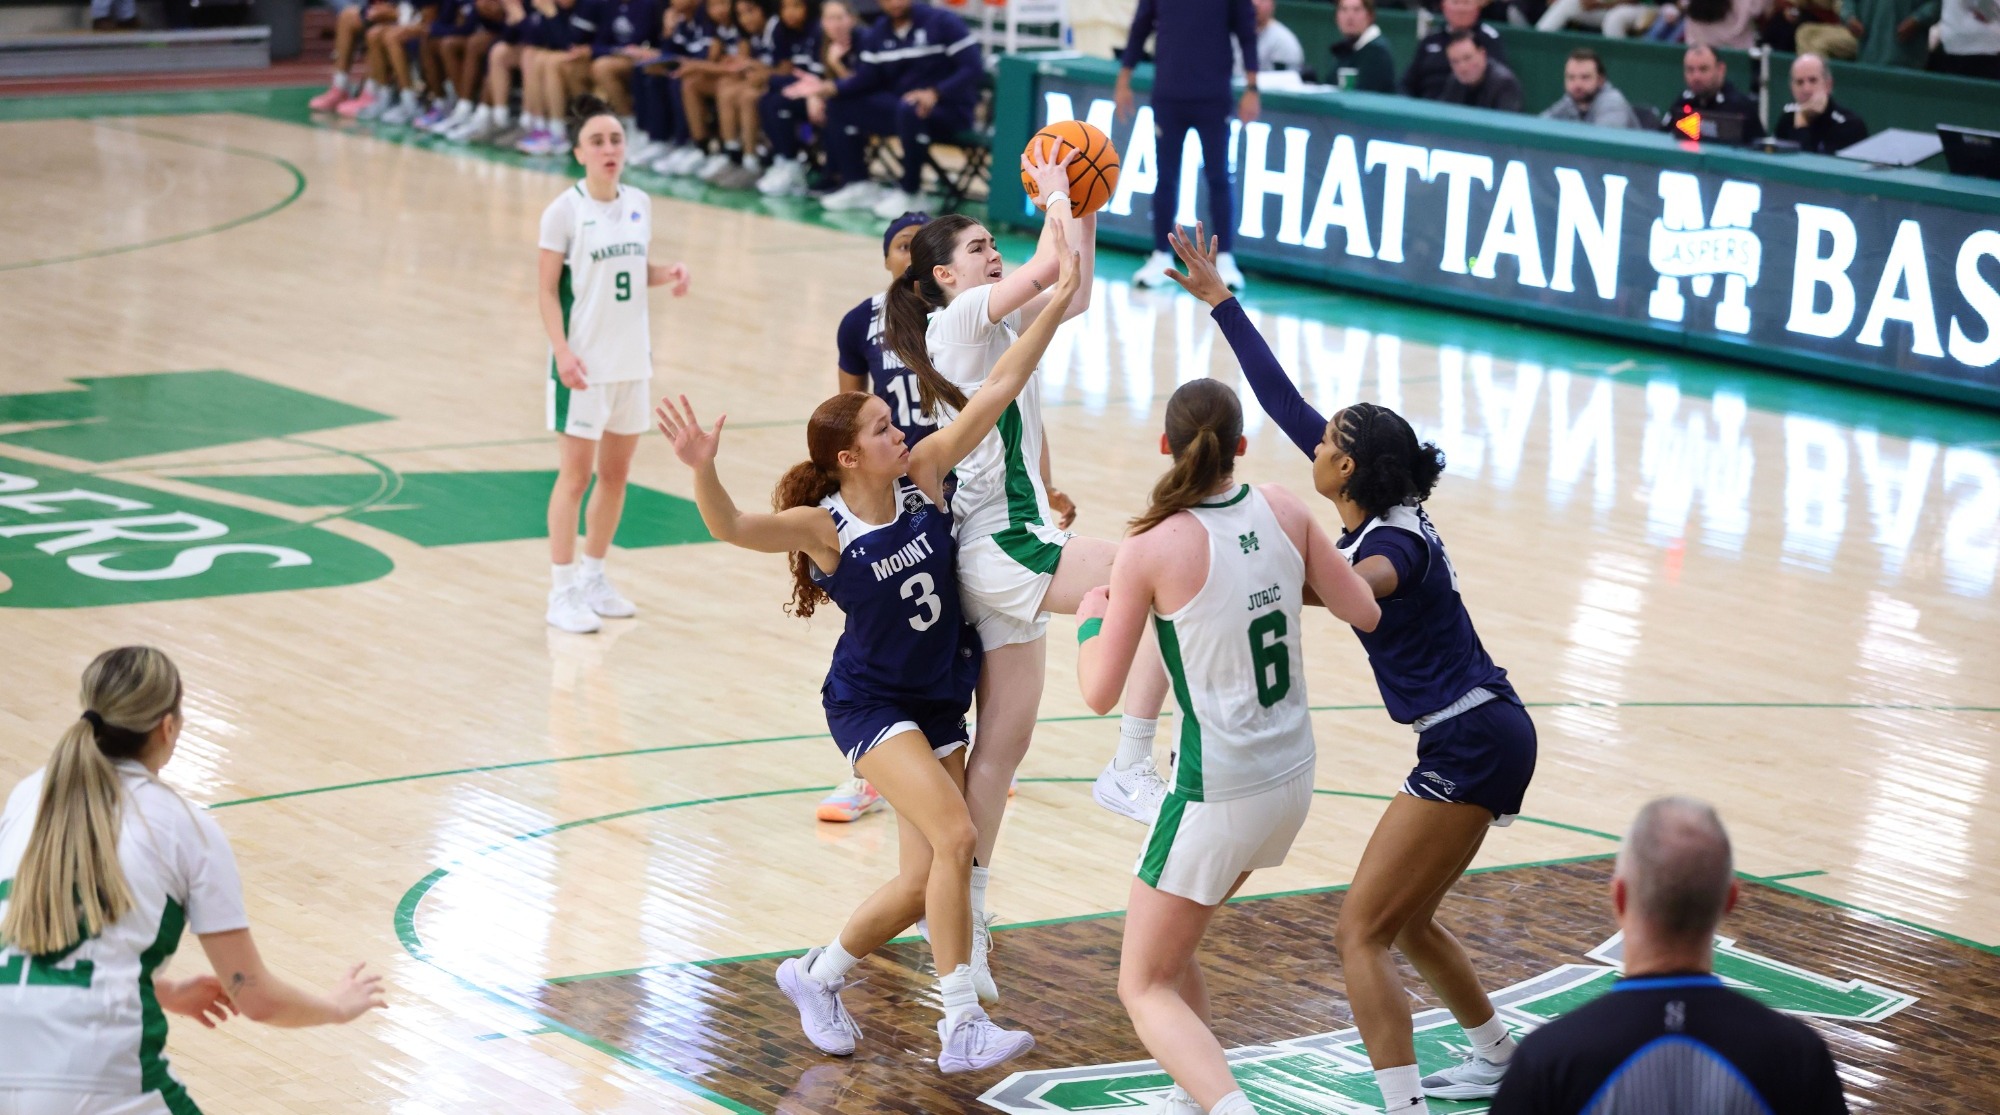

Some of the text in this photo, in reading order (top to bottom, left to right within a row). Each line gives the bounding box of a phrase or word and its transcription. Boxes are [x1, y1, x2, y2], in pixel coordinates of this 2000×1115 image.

[590, 242, 646, 263] MANHATTA
[616, 271, 631, 302] 9
[1785, 202, 2000, 369] BAS
[886, 374, 938, 427] 15
[871, 532, 934, 582] MOUNT
[899, 572, 942, 632] 3
[1247, 609, 1290, 709] 6
